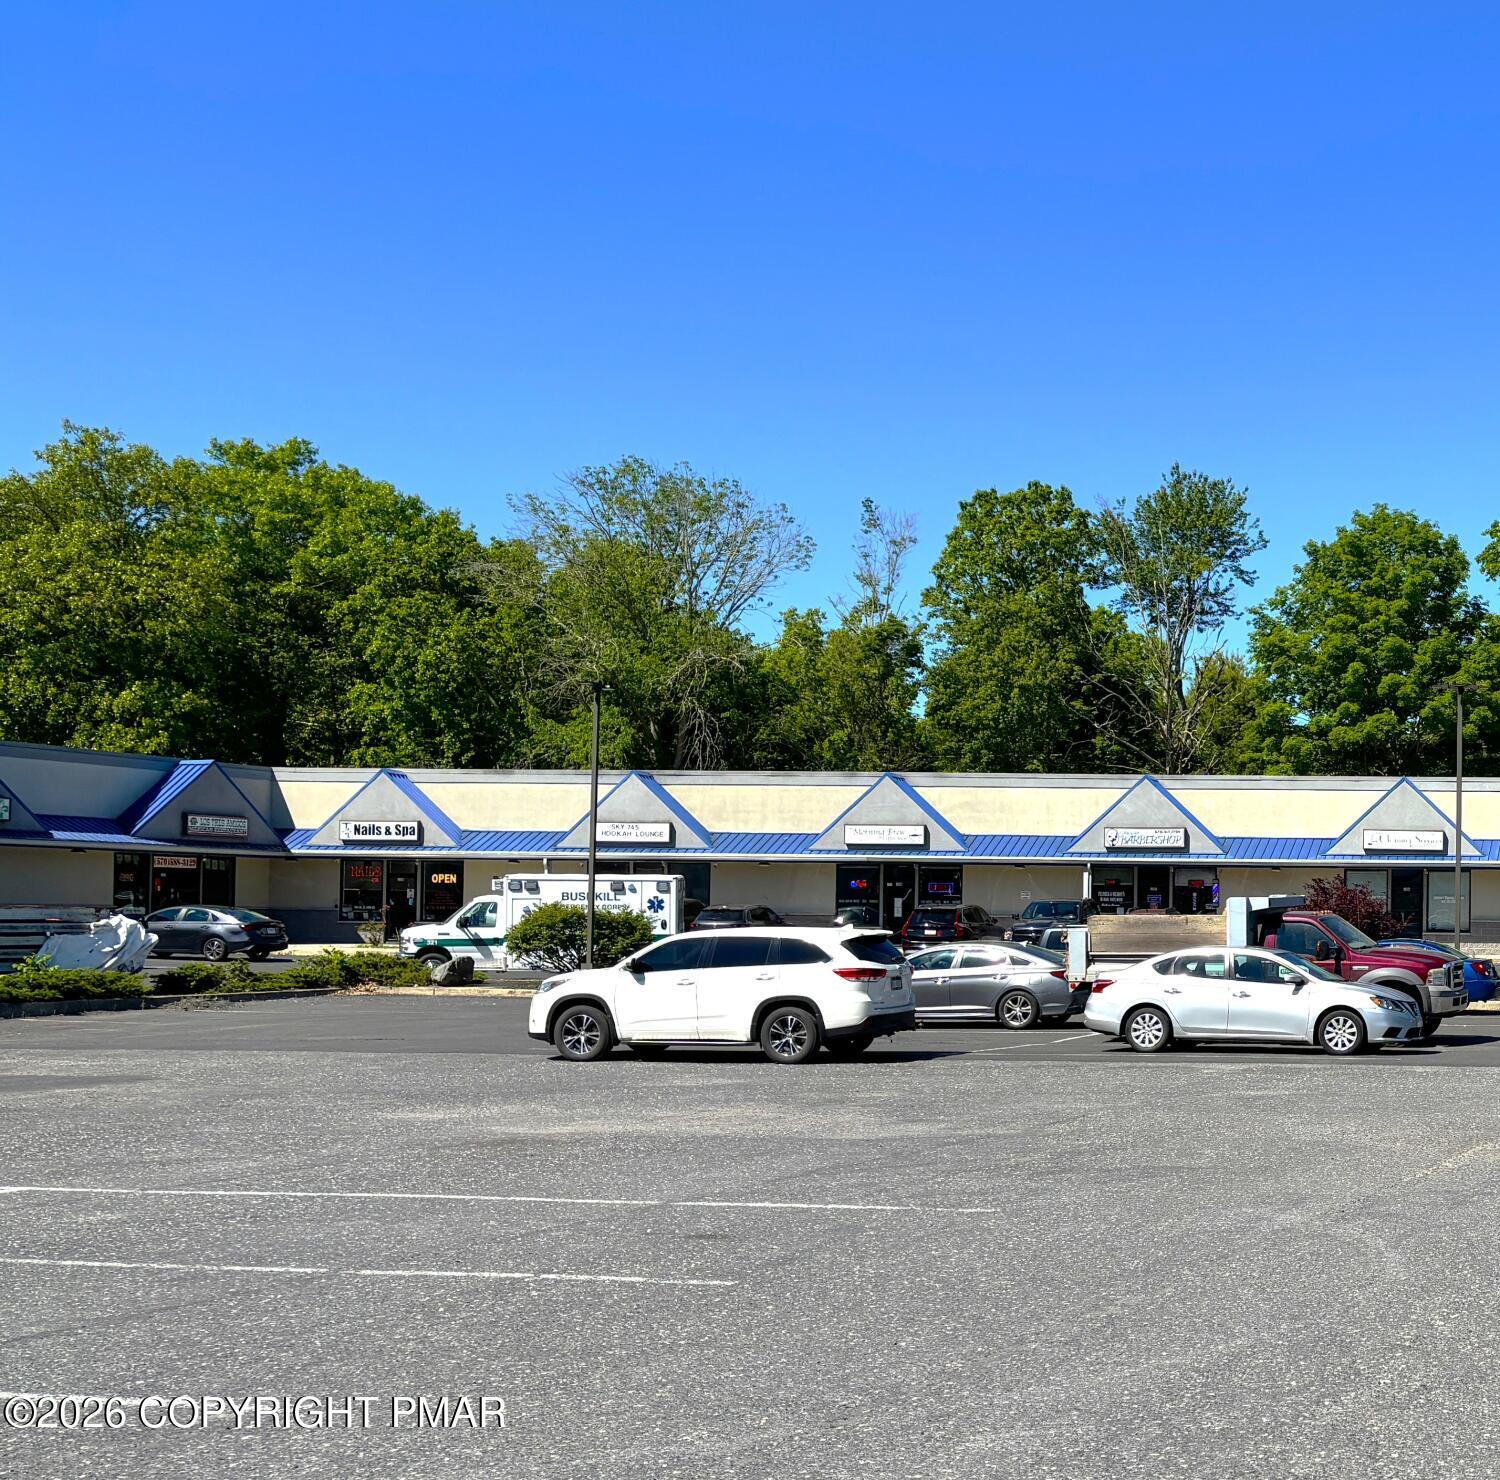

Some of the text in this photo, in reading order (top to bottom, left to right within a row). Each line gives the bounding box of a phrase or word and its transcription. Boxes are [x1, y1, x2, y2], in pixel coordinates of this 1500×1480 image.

[353, 823, 382, 836] Nails
[384, 824, 392, 835] &
[395, 823, 416, 837] Spa
[1120, 835, 1182, 845] BARBERSHOP
[431, 873, 457, 884] OPEN
[561, 891, 621, 901] BUSKILL
